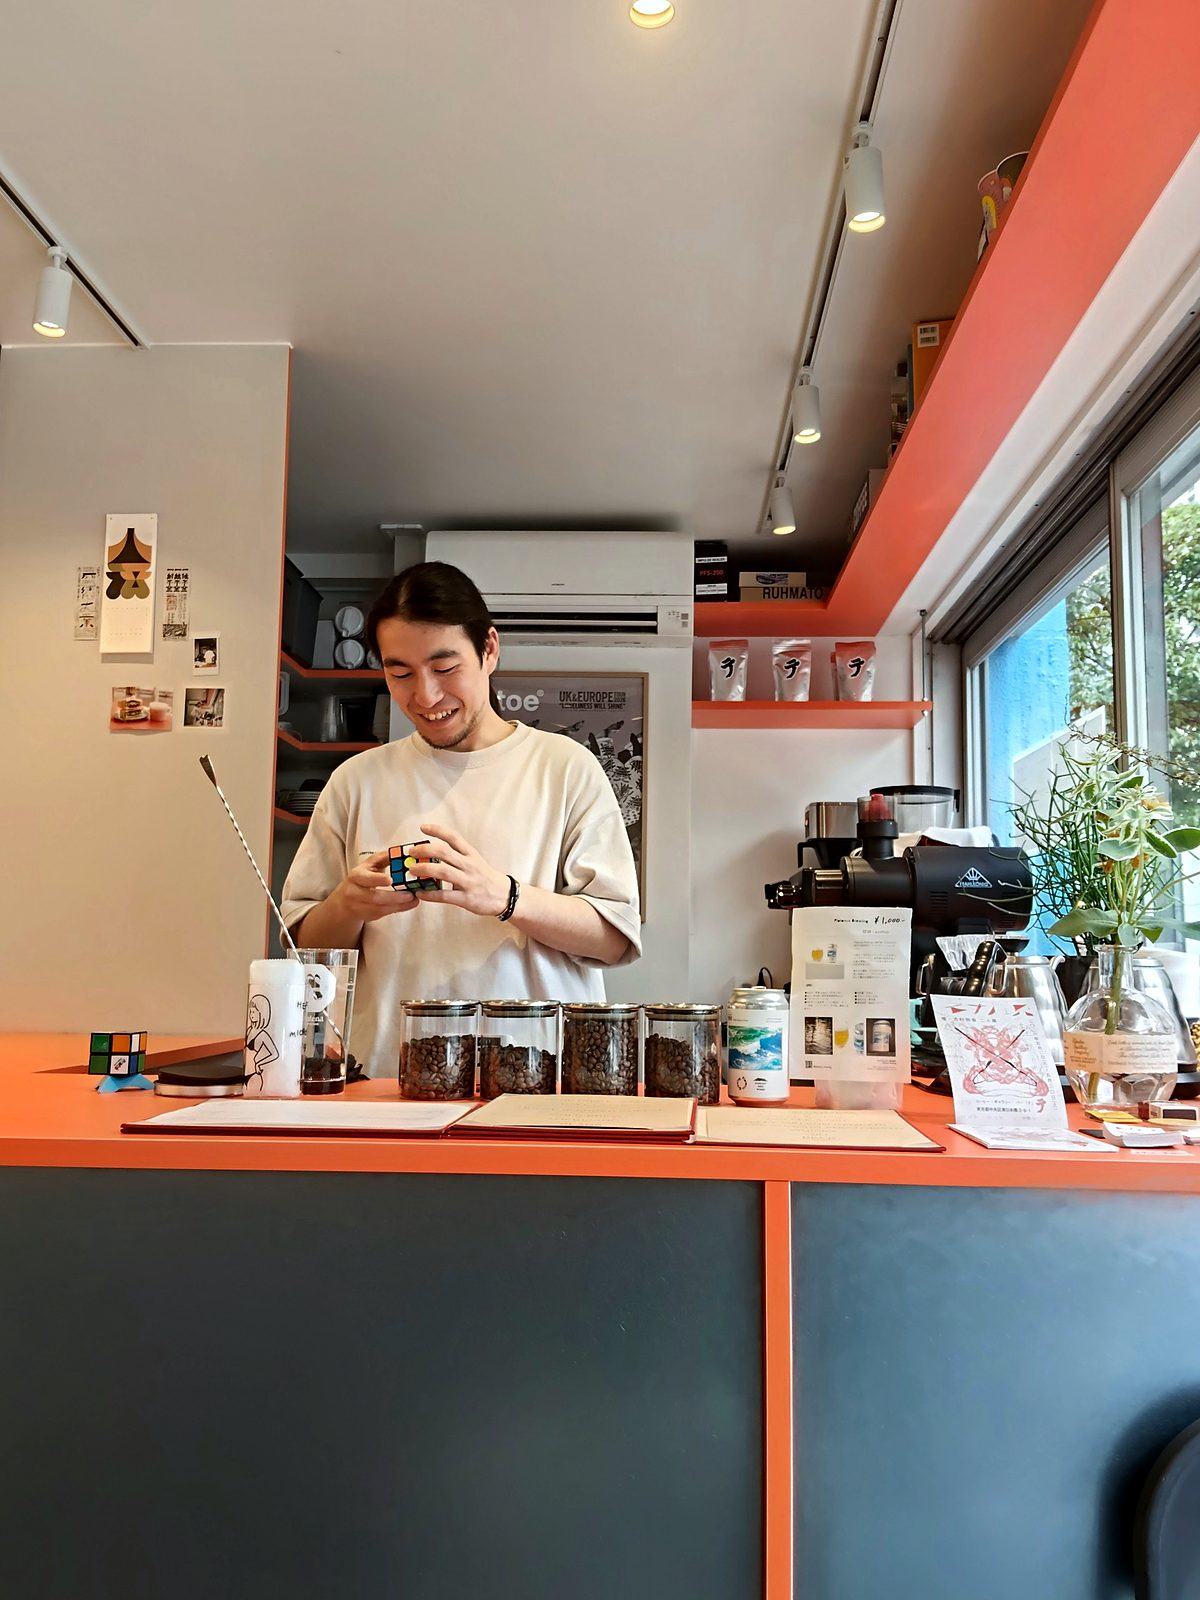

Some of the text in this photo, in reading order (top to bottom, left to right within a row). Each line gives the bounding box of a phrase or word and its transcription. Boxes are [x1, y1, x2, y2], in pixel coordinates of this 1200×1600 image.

[720, 657, 735, 678] テ
[784, 658, 800, 679] テ
[848, 657, 864, 678] テ
[559, 691, 613, 702] UK&EUROPE
[1036, 1098, 1046, 1113] テ
